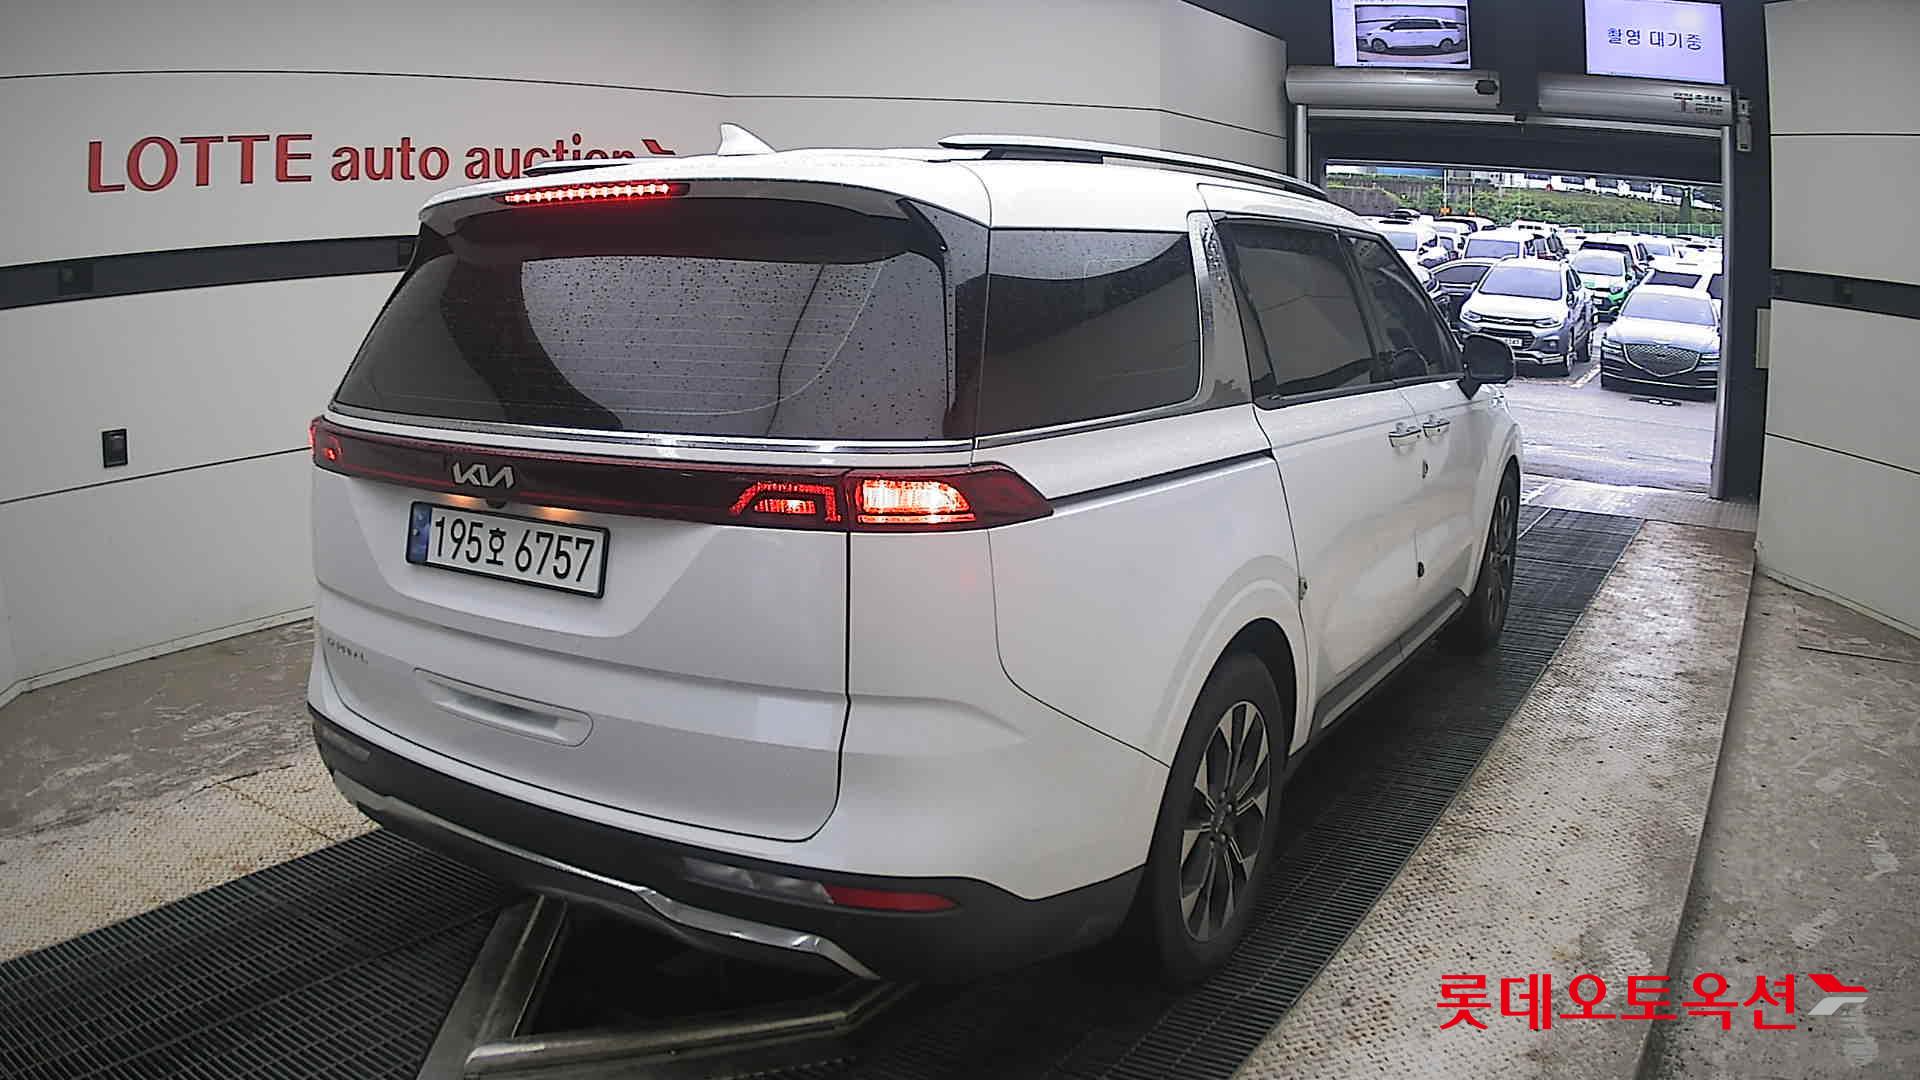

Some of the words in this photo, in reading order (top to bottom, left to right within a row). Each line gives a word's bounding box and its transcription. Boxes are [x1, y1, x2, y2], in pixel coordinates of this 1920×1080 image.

[1648, 30, 1702, 51] 대기중
[88, 134, 312, 193] LOTTE
[331, 137, 449, 181] auto
[464, 133, 636, 179] aucti
[452, 461, 516, 488] KIA
[434, 516, 506, 566] 195호
[514, 528, 595, 582] 6757
